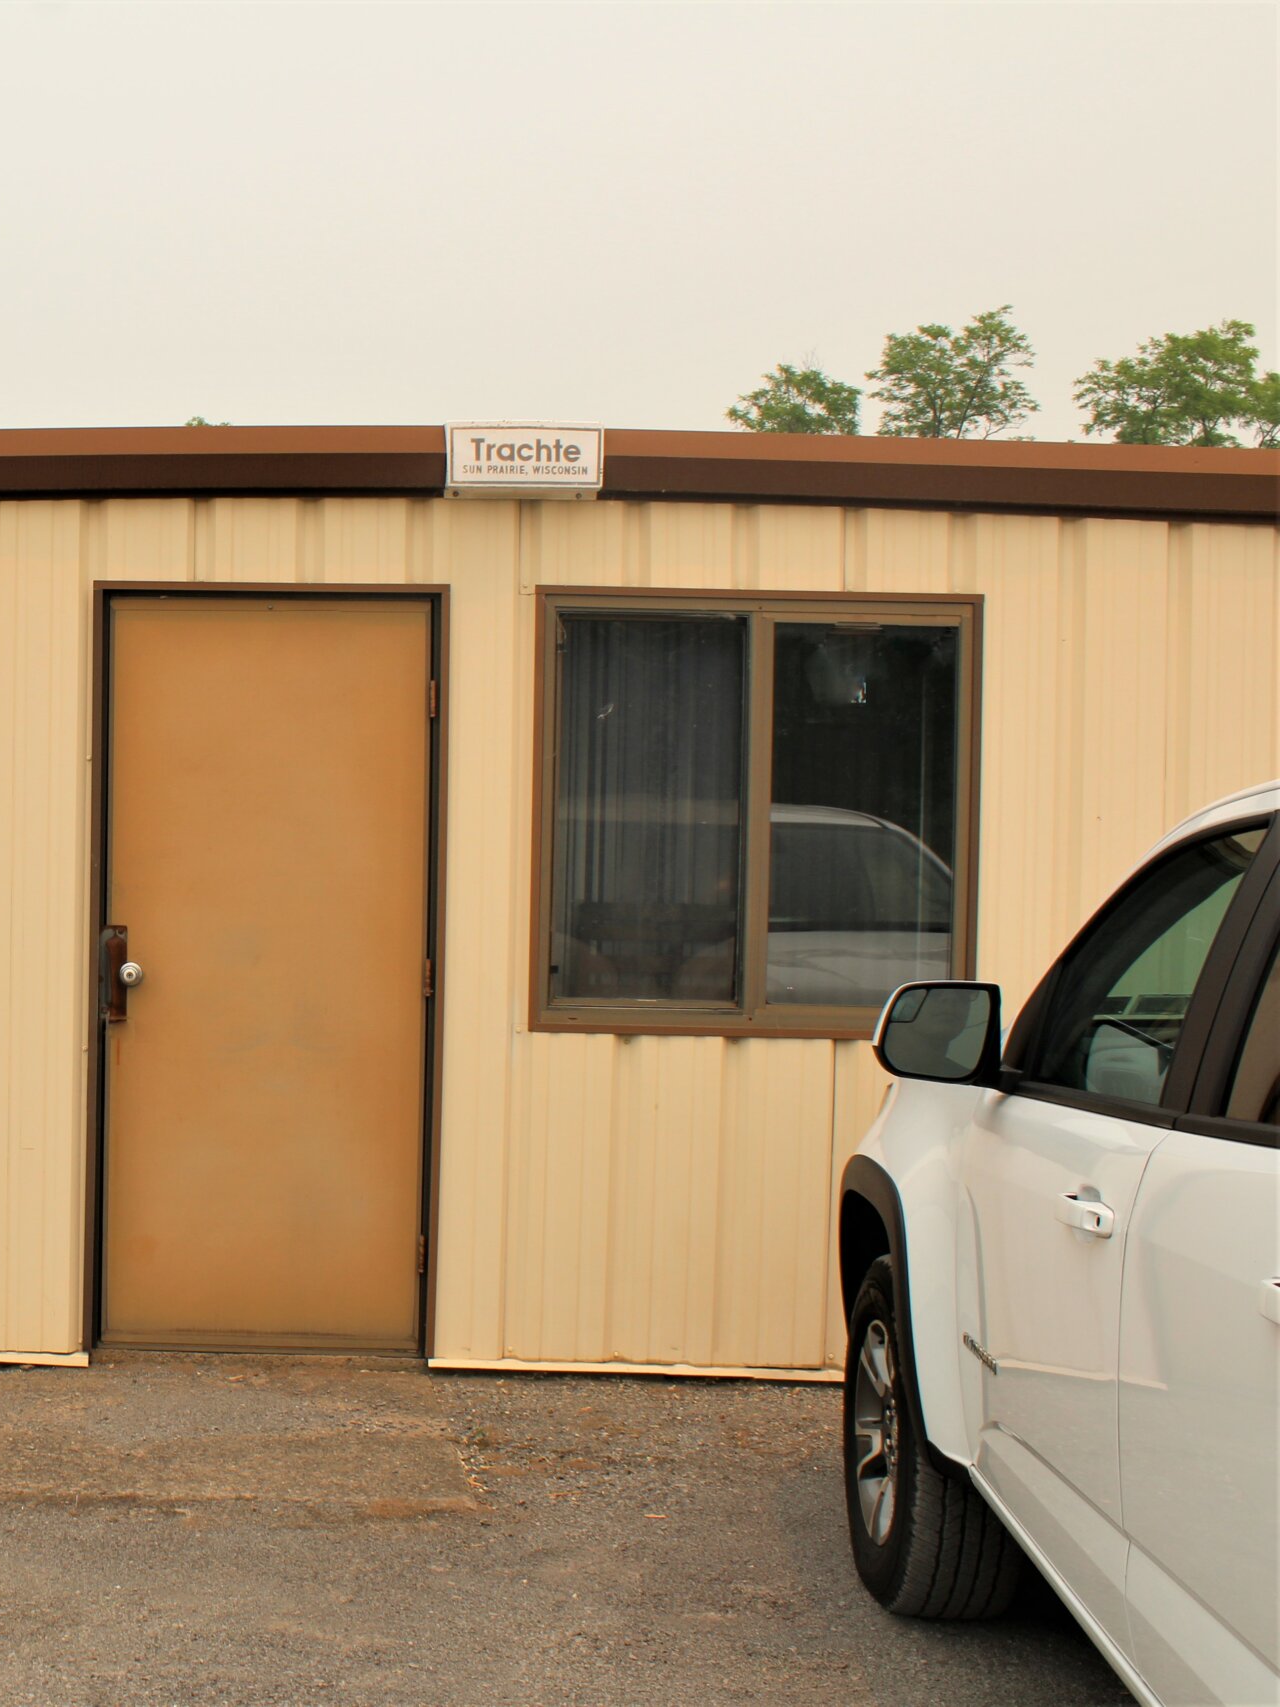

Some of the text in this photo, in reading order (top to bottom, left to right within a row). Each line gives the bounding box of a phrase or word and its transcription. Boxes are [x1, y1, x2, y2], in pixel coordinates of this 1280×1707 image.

[471, 438, 581, 463] Trachte
[462, 465, 588, 476] SUN PRAIRIE, WISCONSIN
